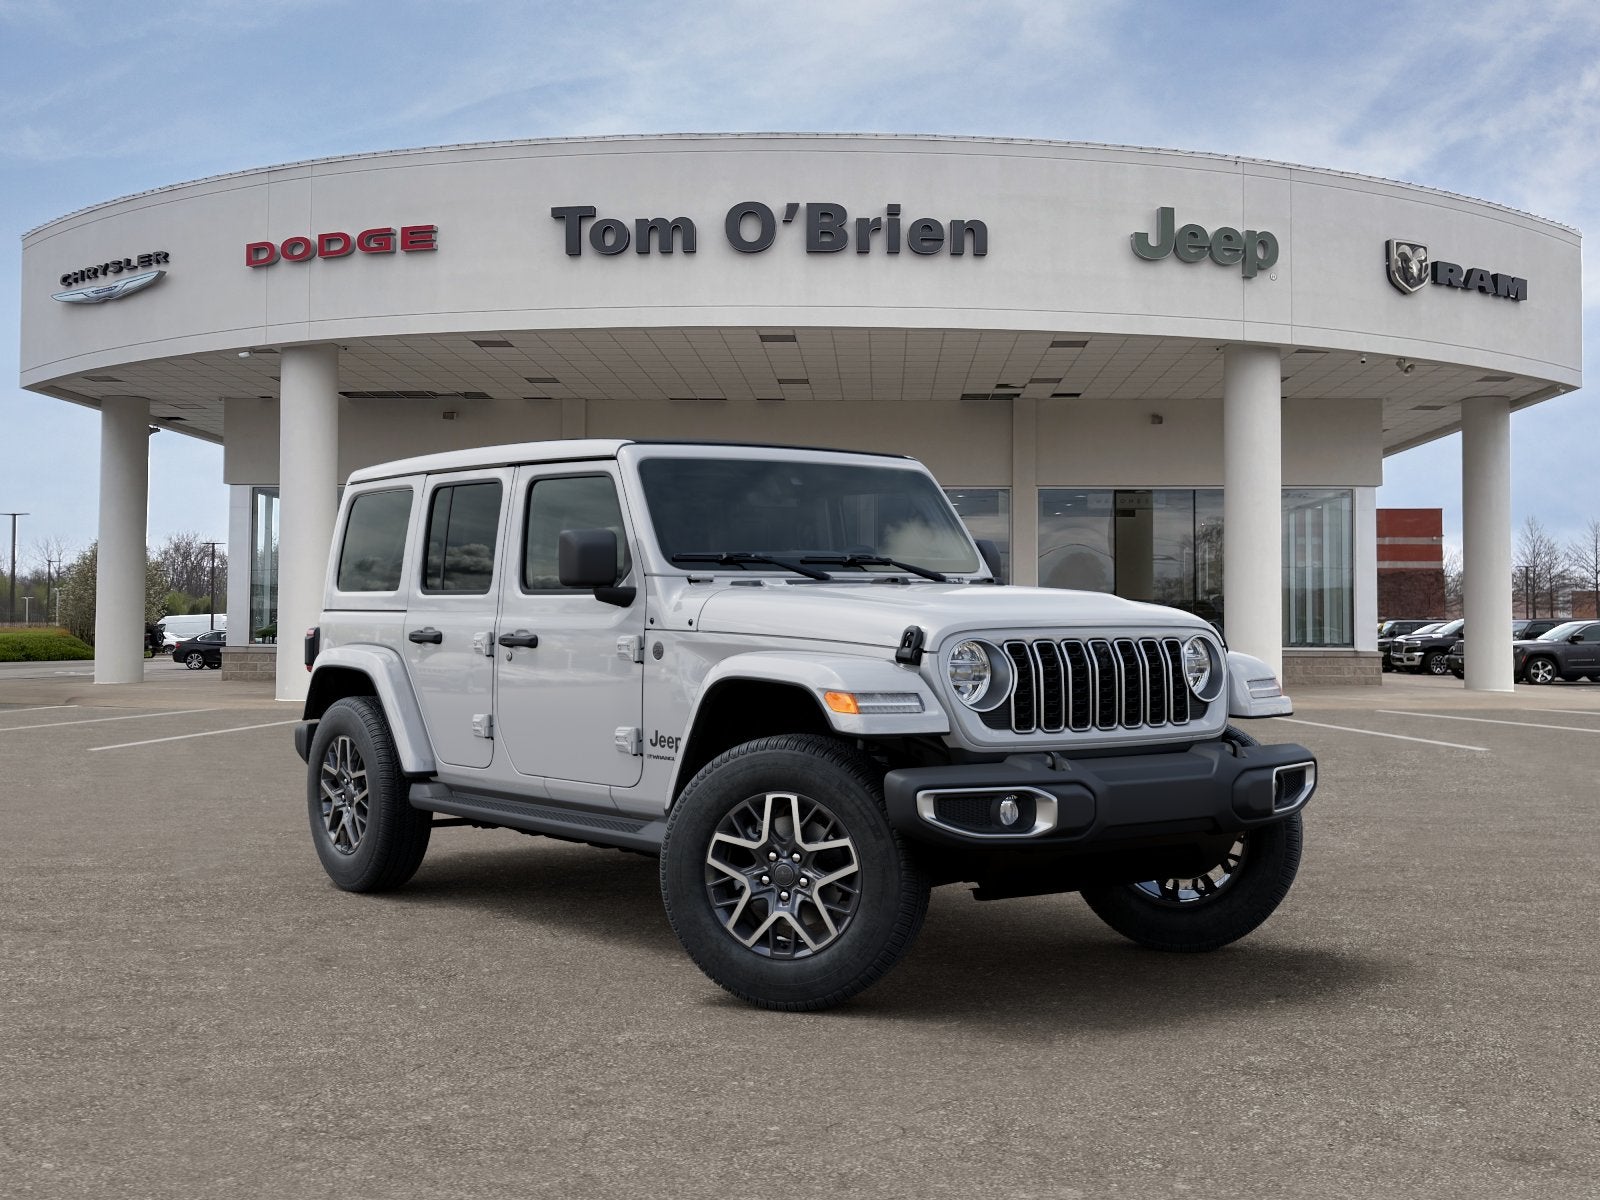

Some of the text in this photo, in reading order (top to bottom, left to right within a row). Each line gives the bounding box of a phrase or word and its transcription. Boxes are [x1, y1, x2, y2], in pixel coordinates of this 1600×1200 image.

[246, 225, 438, 268] DODGE
[551, 201, 988, 256] Tom O'Brien
[1131, 207, 1279, 279] Jeep
[60, 251, 170, 286] CHRYSLER
[1431, 261, 1528, 302] RAM
